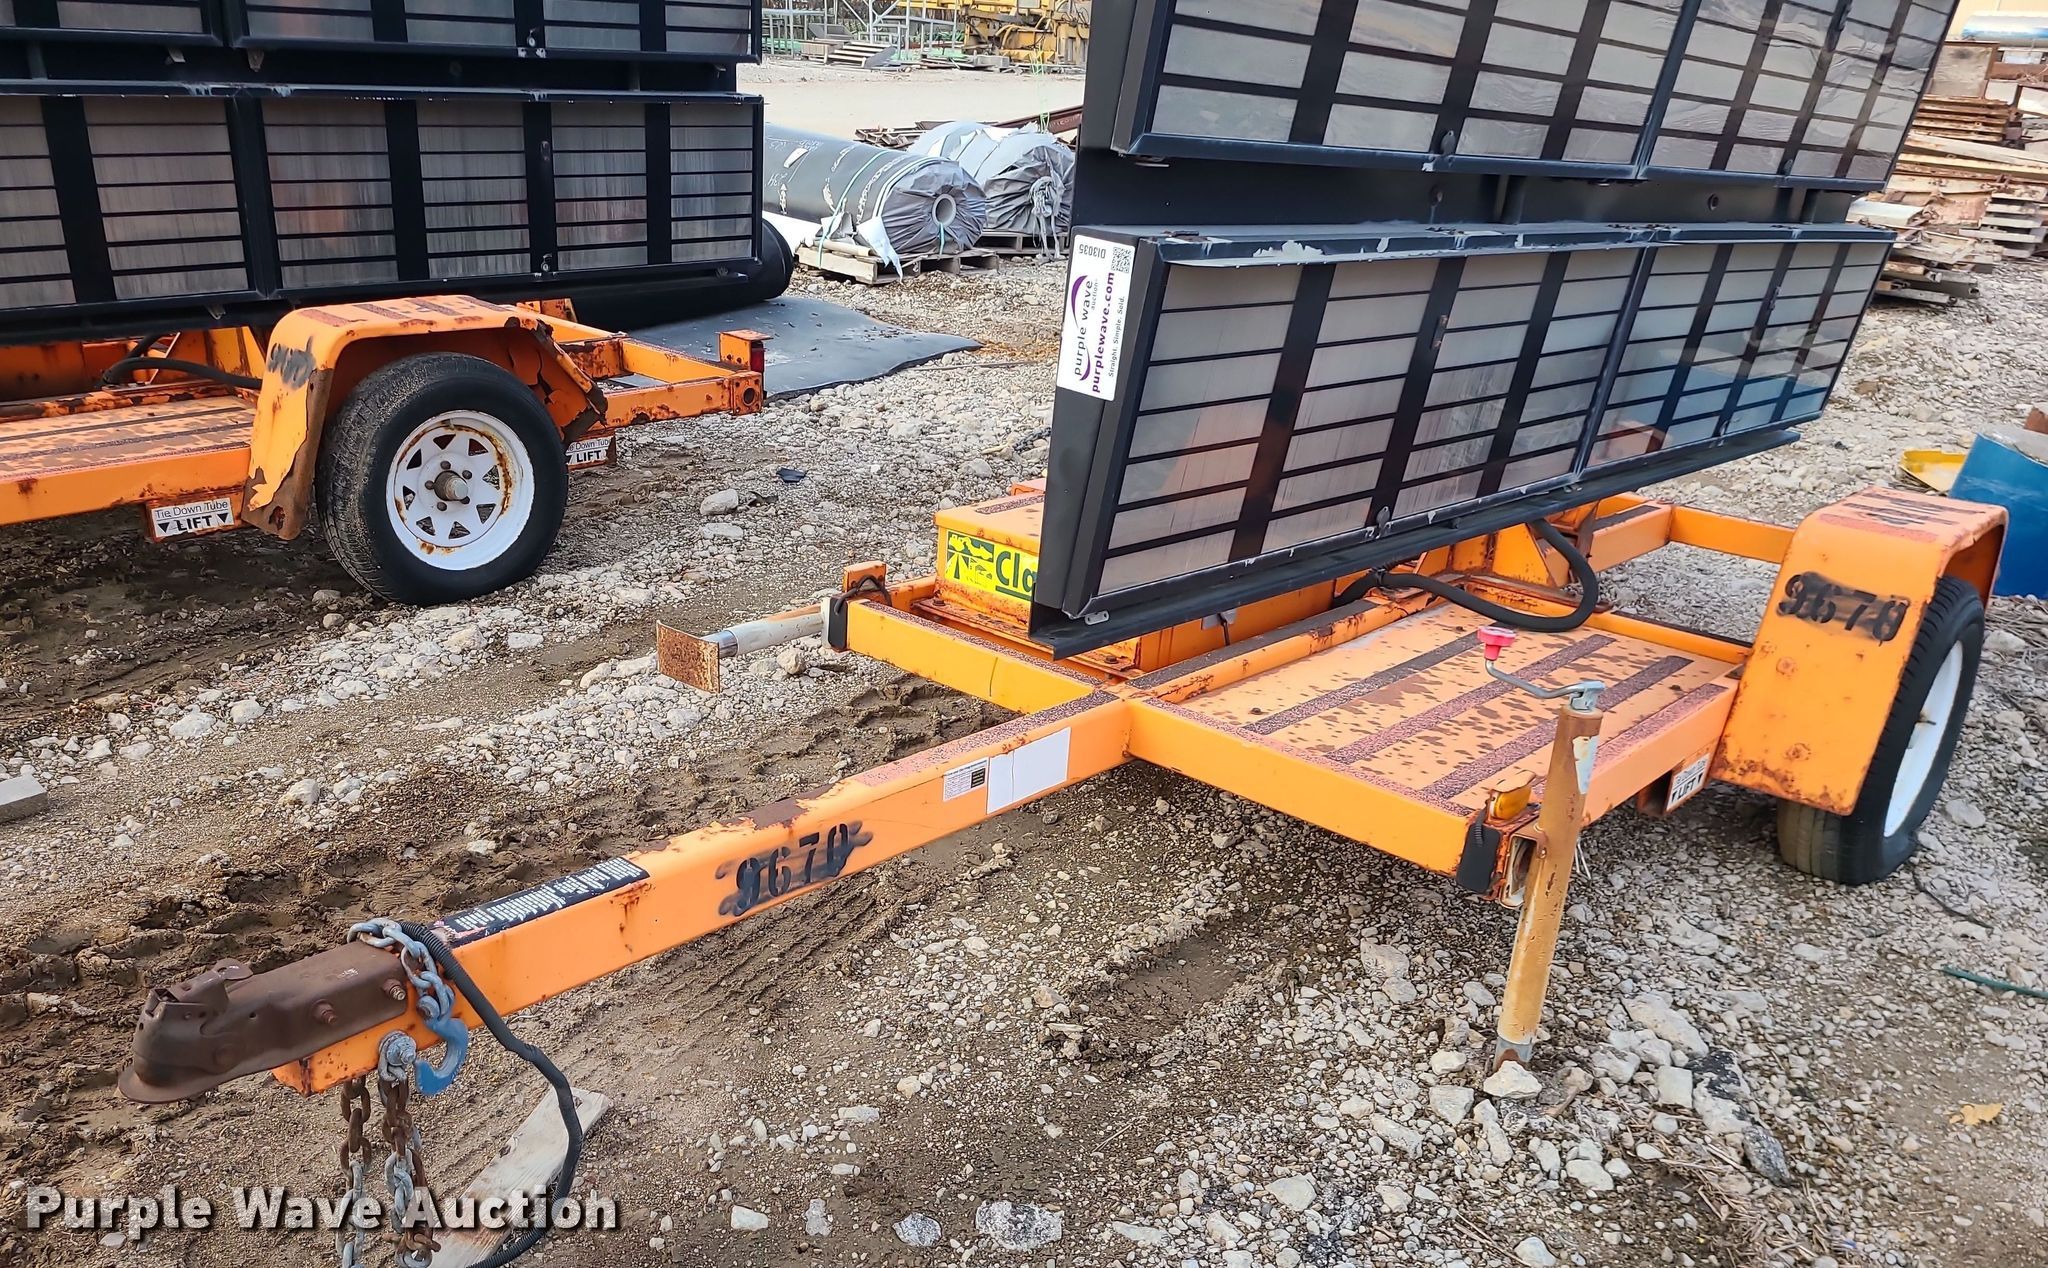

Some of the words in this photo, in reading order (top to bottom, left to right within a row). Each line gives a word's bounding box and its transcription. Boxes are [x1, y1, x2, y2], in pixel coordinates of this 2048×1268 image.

[1090, 282, 1098, 311] auction
[1074, 326, 1087, 376] purple
[1081, 280, 1093, 321] wave
[1091, 272, 1115, 393] purplewave.com
[1112, 317, 1122, 344] Simple.
[1108, 346, 1119, 378] Straight.
[575, 441, 595, 450] Down
[596, 438, 609, 447] Tub
[576, 450, 602, 462] LIFT
[155, 509, 172, 519] Tie
[172, 504, 202, 516] Down
[203, 500, 228, 511] Tube
[175, 515, 213, 531] LIFT
[995, 550, 1038, 593] Cla
[1677, 777, 1697, 800] LIFT
